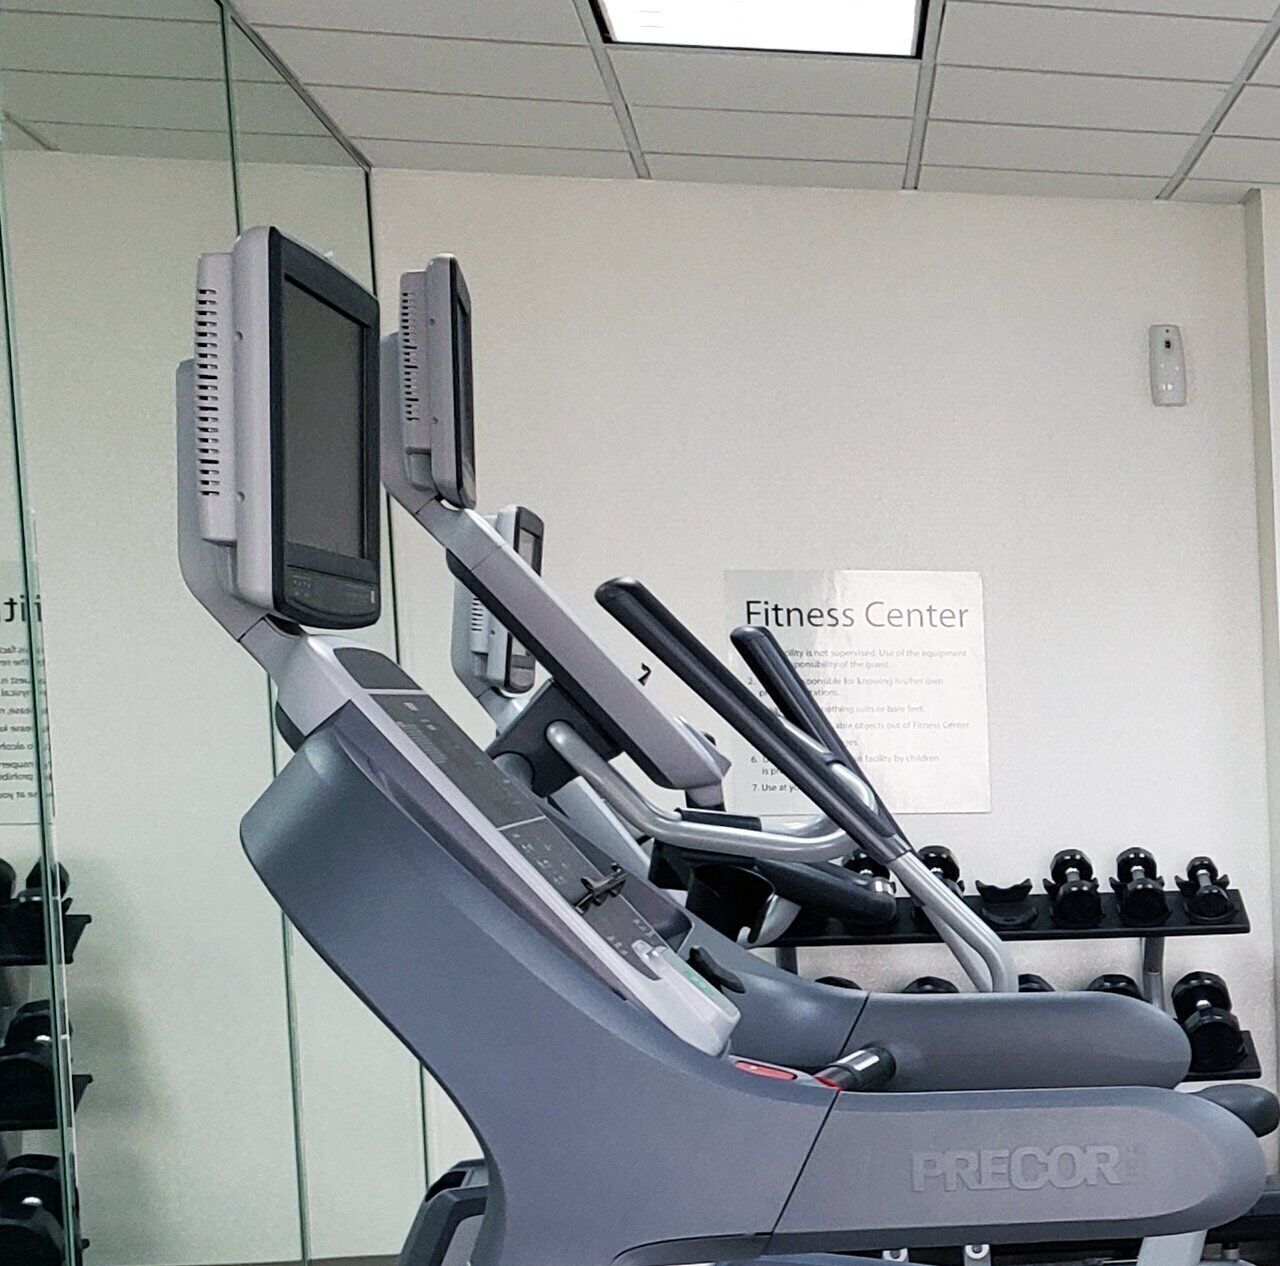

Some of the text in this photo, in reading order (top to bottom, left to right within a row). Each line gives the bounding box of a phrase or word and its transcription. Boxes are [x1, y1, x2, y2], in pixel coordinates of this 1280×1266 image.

[745, 600, 969, 628] Fitness Center
[814, 649, 829, 657] not
[879, 649, 895, 657] Use
[896, 649, 905, 657] of
[906, 649, 920, 657] the
[922, 650, 967, 659] equipment
[850, 660, 863, 668] the
[911, 1144, 1123, 1192] PRECOR
